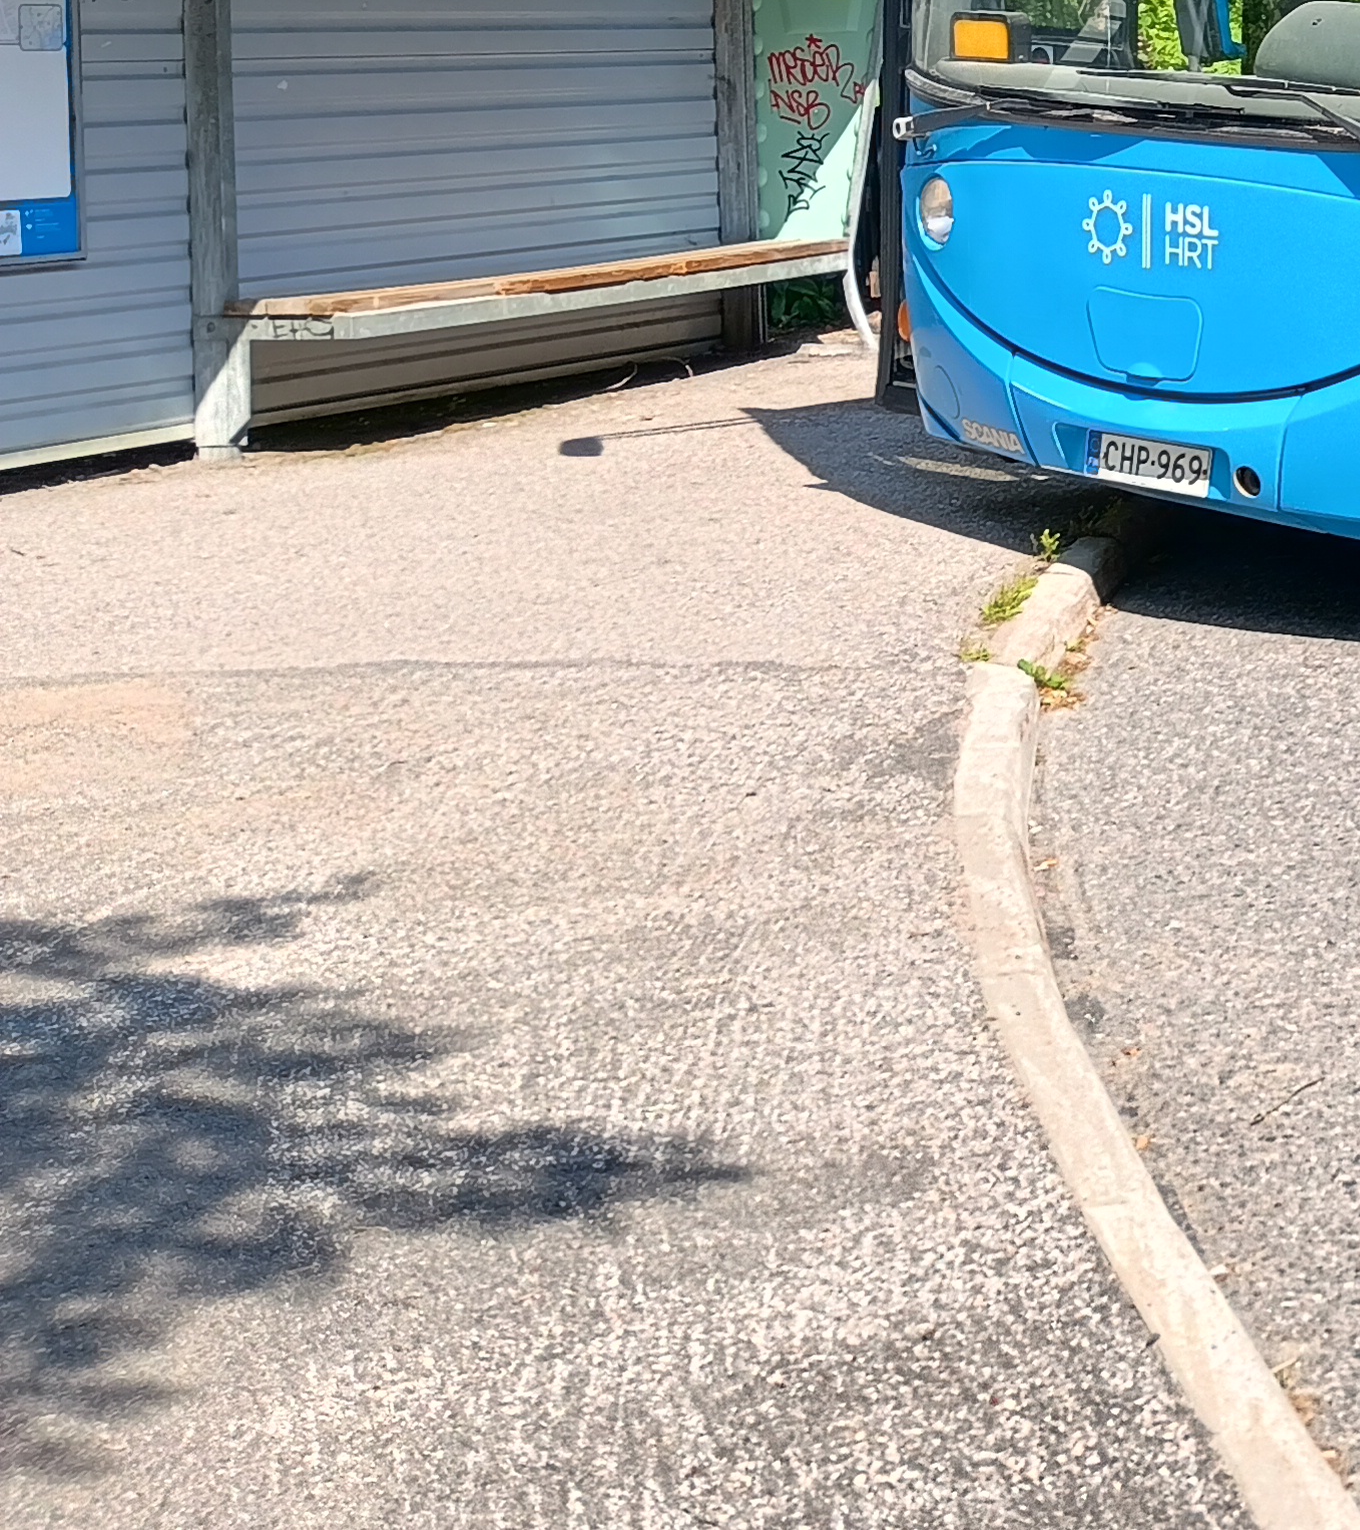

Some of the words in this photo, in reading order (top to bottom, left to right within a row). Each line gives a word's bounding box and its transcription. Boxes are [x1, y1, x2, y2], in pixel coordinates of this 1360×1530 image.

[1165, 202, 1219, 237] HSL
[1165, 235, 1219, 269] HRT
[962, 419, 1026, 454] SCANIA
[1102, 440, 1202, 485] CHP-969
